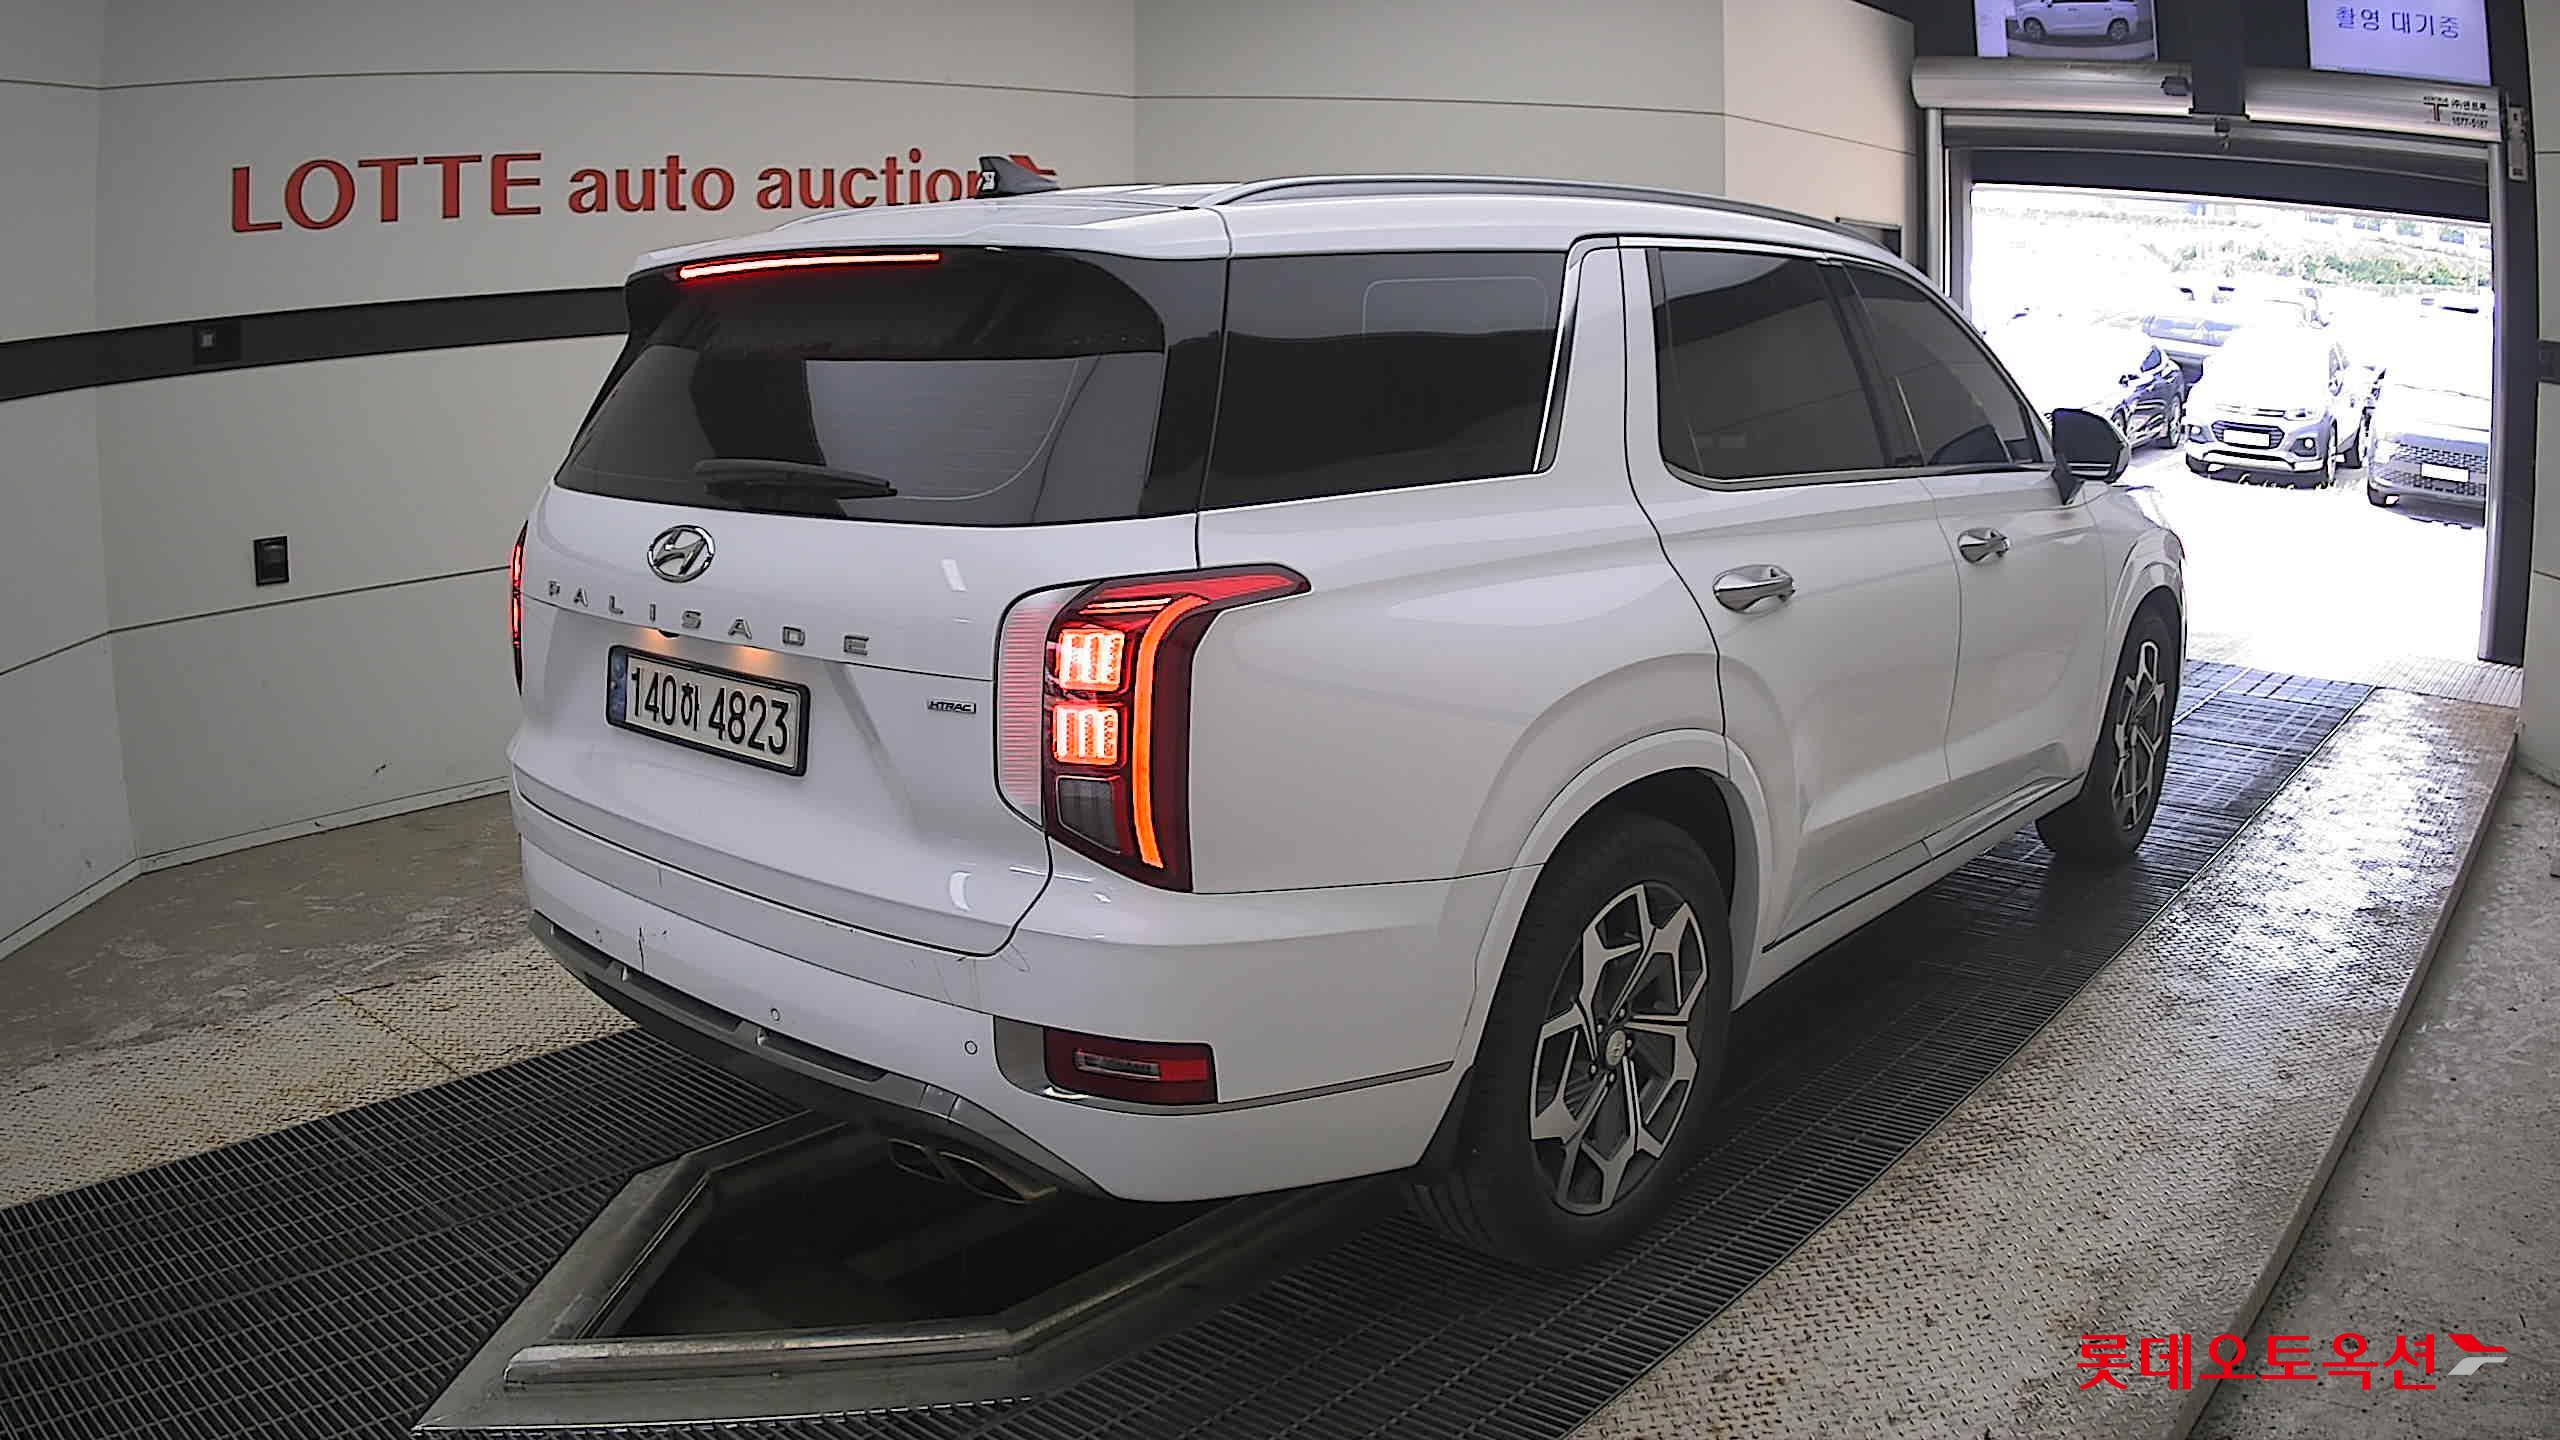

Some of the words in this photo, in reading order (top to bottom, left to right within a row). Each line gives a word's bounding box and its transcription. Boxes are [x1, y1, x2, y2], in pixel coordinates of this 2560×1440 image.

[2391, 12, 2460, 39] 대기중
[231, 152, 542, 233] LOTTE
[568, 154, 735, 214] auto
[548, 579, 870, 656] PALISADE
[631, 667, 700, 731] 140하
[708, 687, 789, 755] 4823
[928, 701, 976, 714] HTRAC
